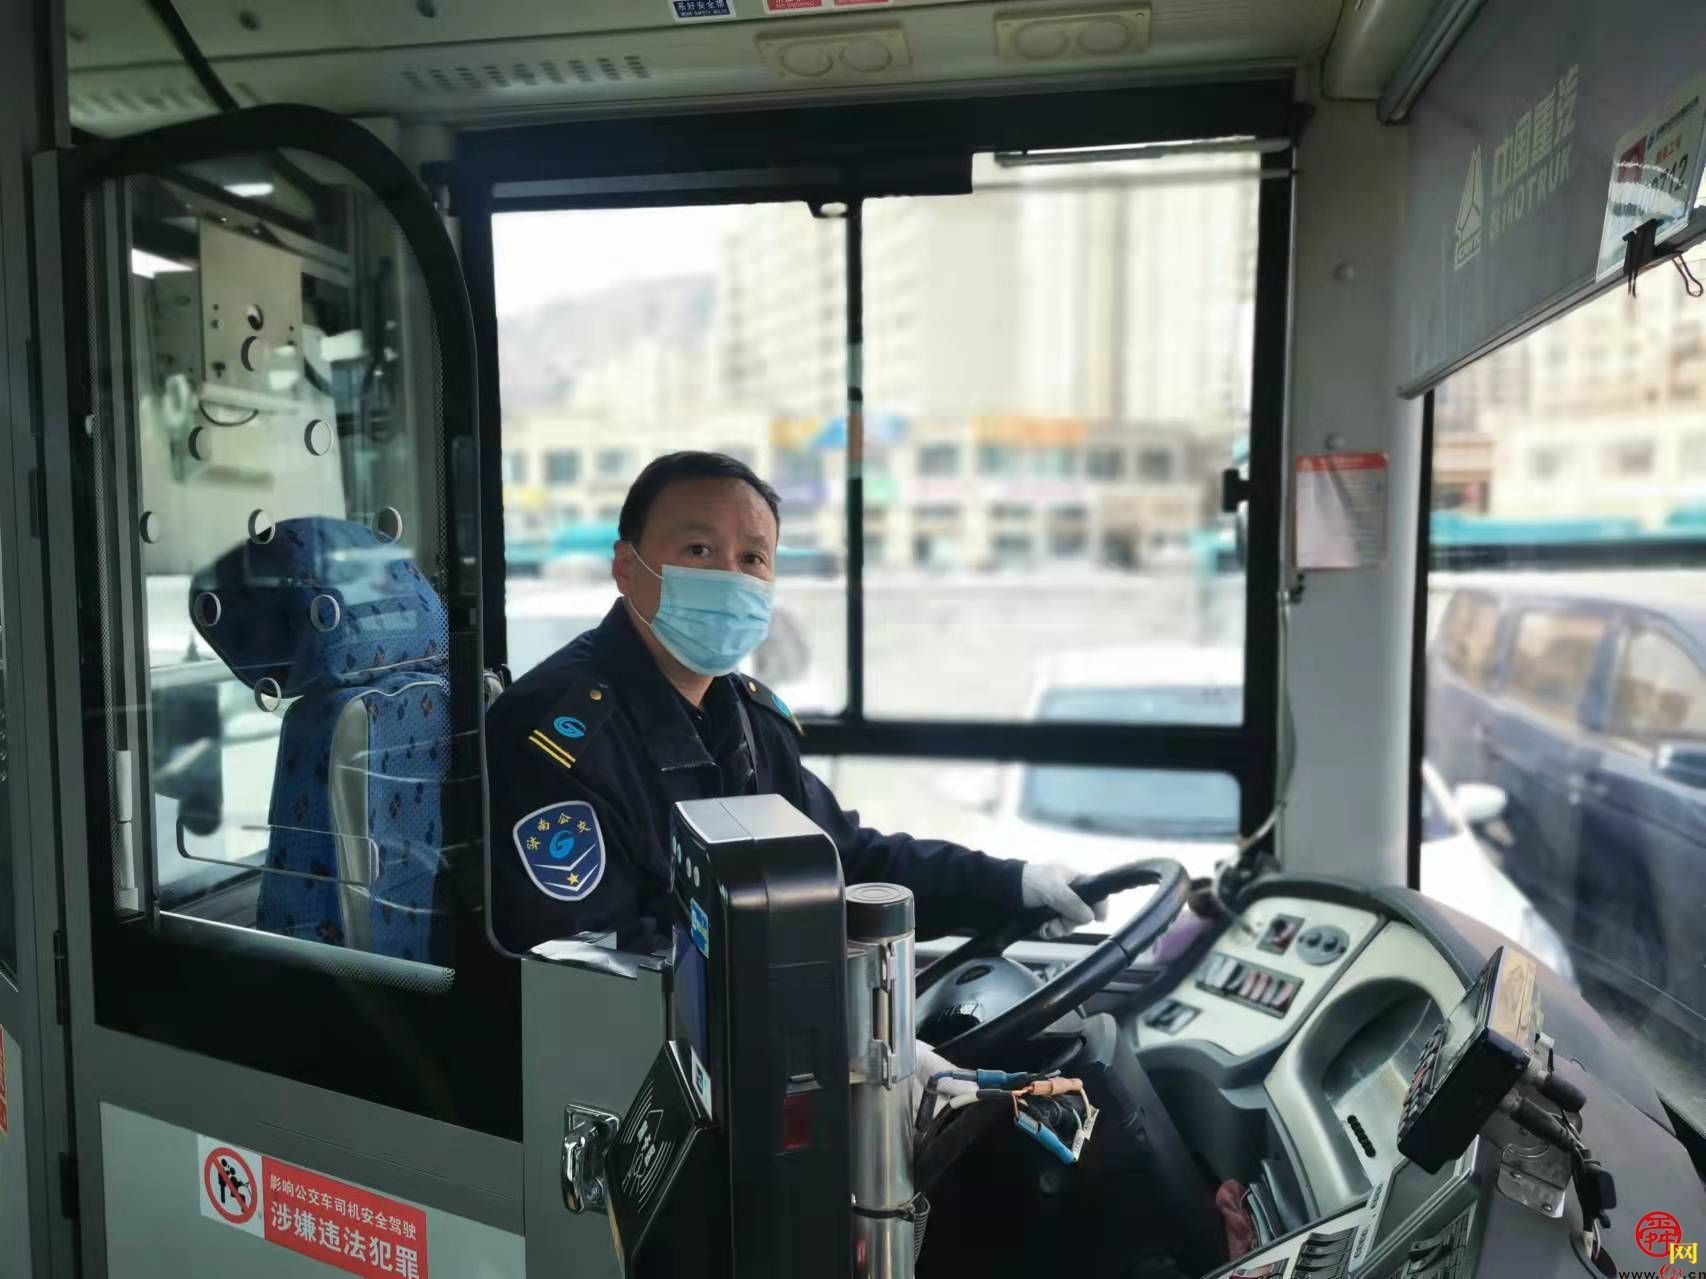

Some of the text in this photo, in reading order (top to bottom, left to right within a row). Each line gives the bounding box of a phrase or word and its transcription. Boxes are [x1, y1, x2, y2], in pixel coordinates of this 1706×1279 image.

[1488, 146, 1571, 241] SINOTRUK
[270, 1174, 417, 1241] 影响公交车司机安全驾驶
[271, 1201, 420, 1279] 涉嫌违法犯罪
